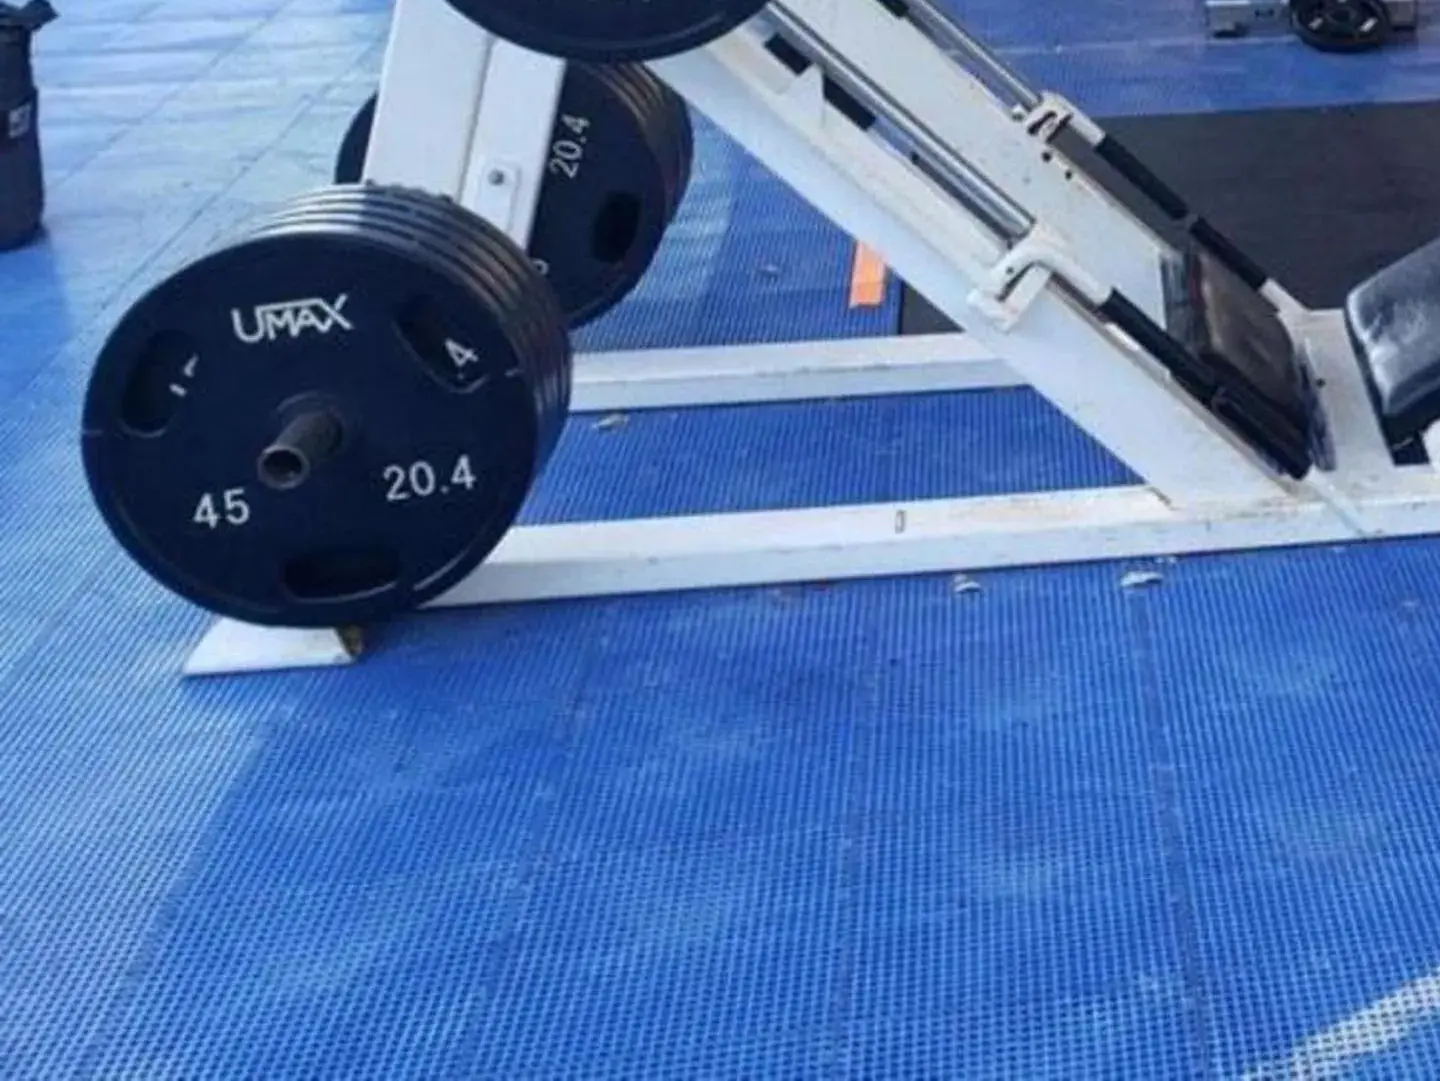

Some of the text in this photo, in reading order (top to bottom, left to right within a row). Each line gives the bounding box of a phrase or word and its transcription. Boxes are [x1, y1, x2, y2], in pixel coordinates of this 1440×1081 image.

[549, 114, 591, 178] 20.4
[231, 294, 354, 343] UMAX
[383, 454, 476, 501] 20.4
[193, 488, 250, 528] 45
